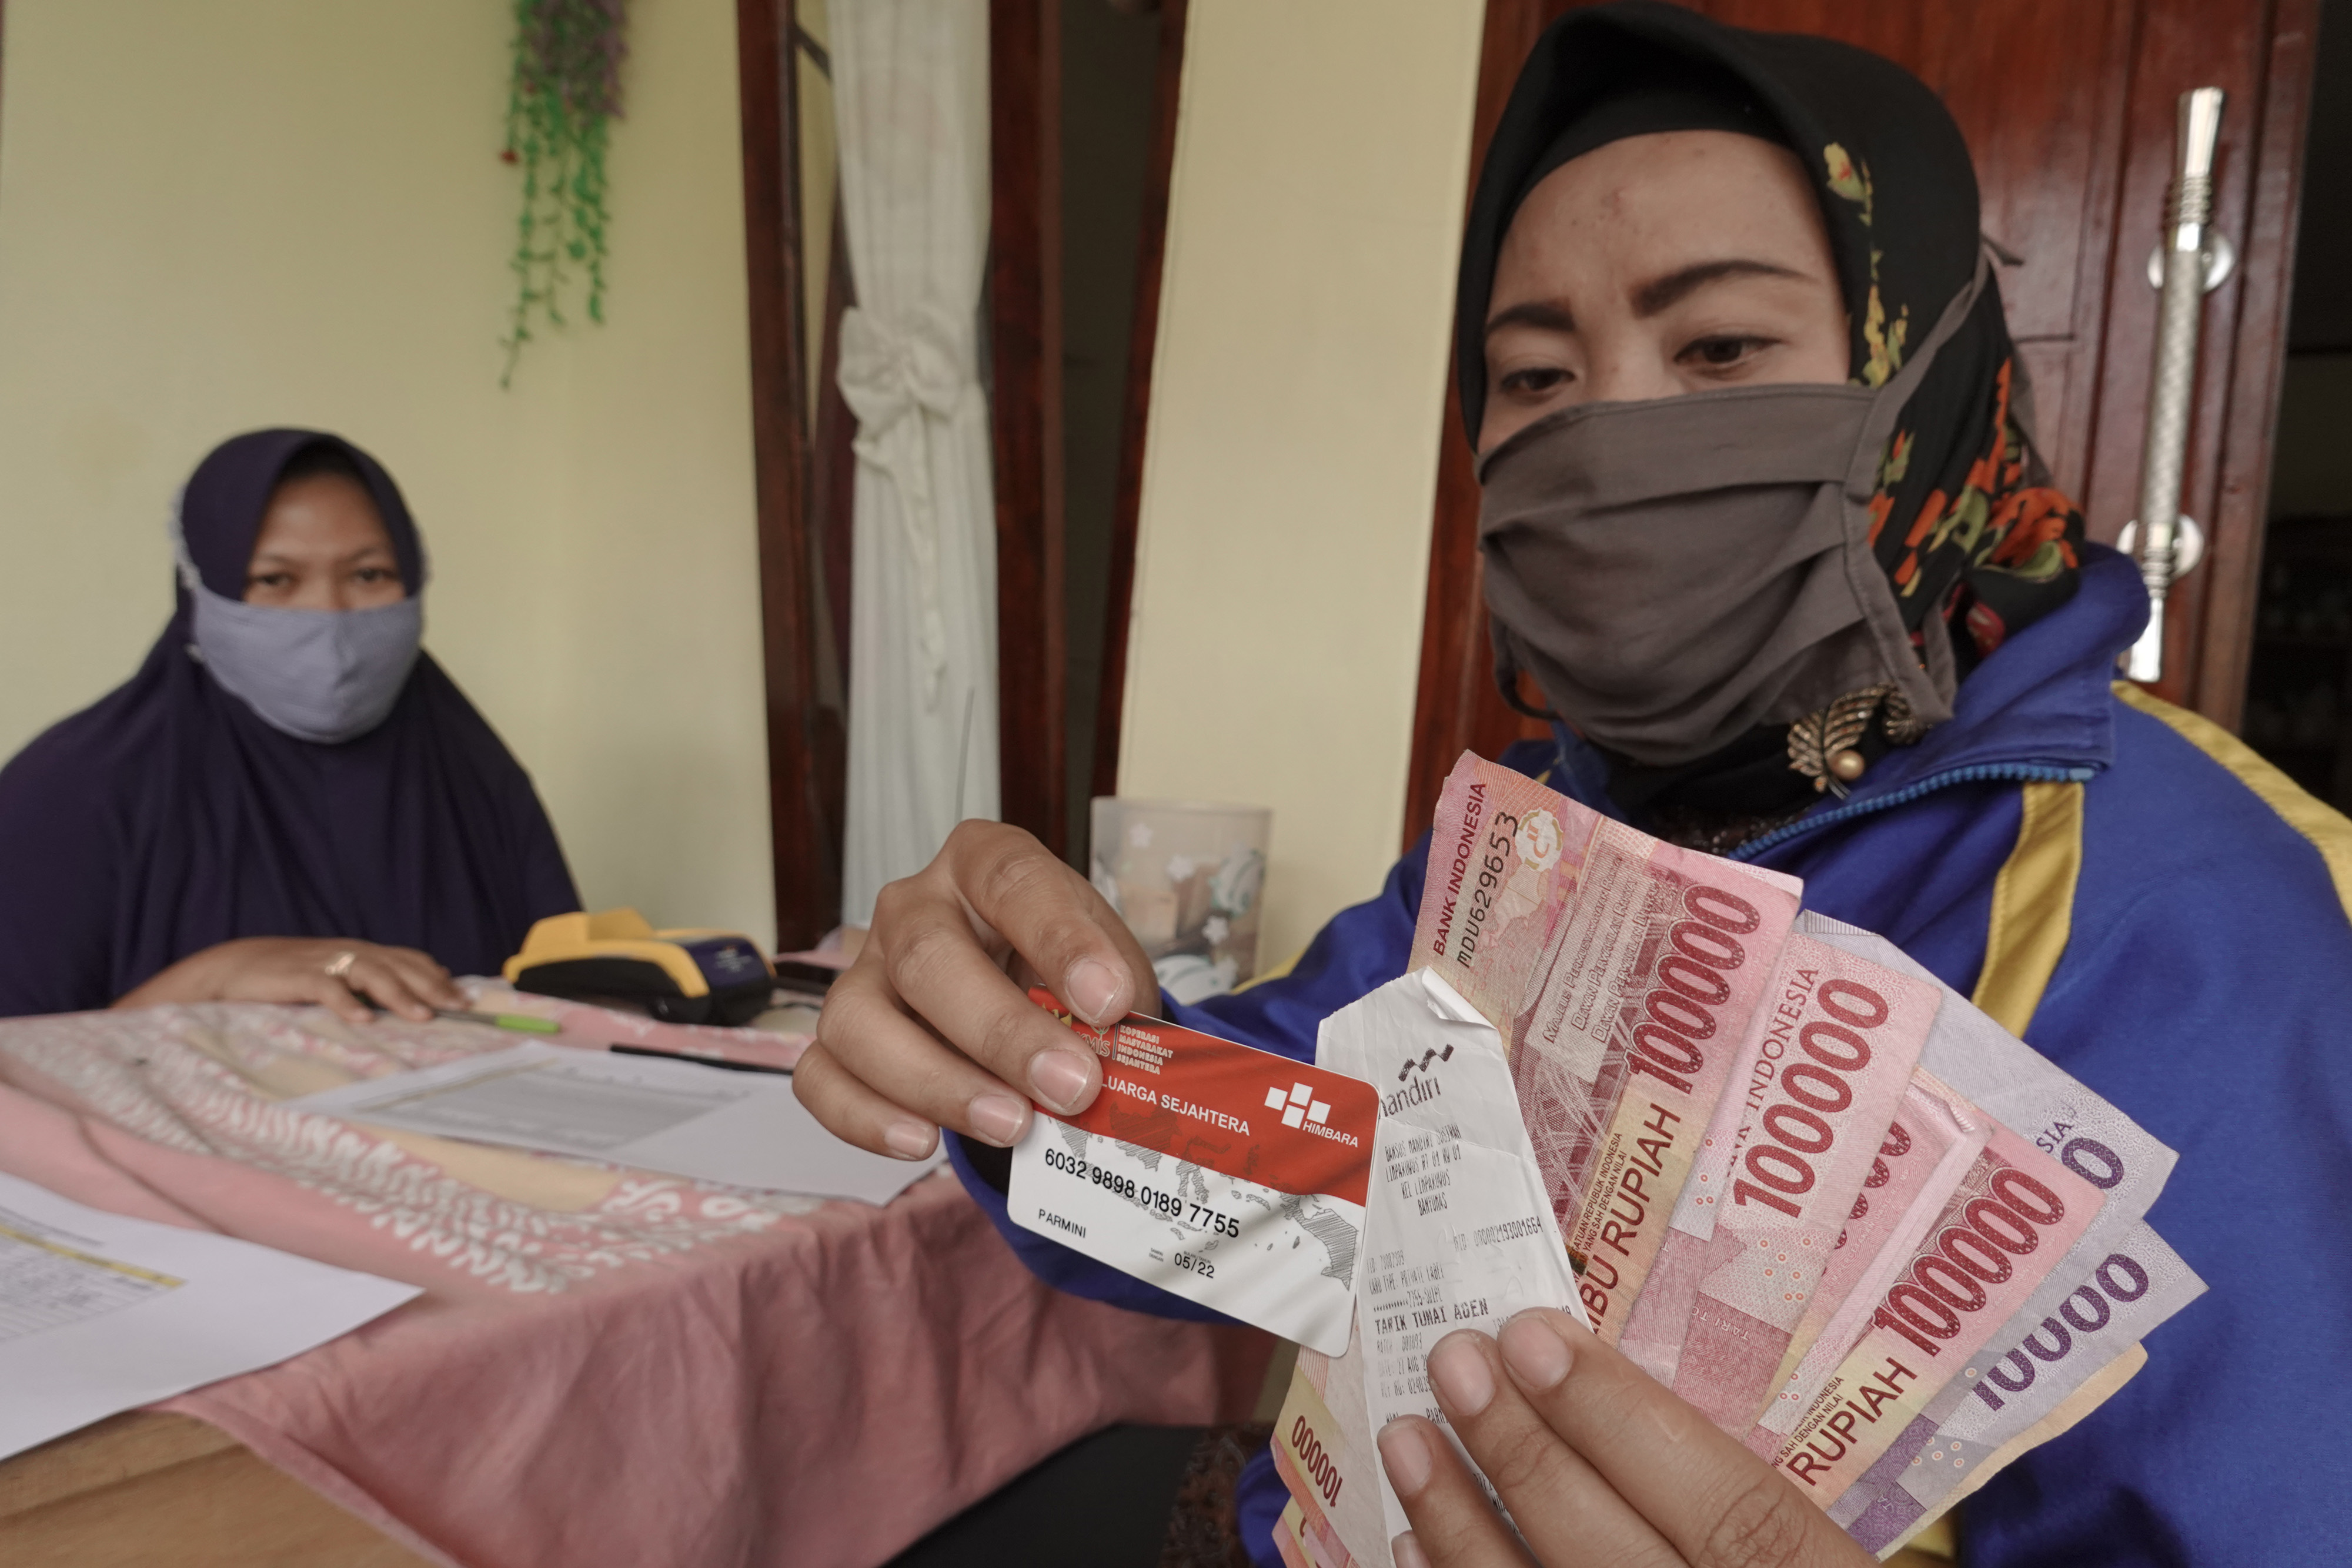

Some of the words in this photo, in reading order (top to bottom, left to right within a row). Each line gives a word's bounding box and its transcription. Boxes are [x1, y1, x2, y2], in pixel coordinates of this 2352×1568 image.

[1433, 896, 1456, 956] BANK
[1448, 783, 1486, 895] INDONESIA
[1456, 811, 1518, 969] MDU629653
[1625, 884, 1761, 1095] 100000
[1118, 1034, 1174, 1058] MASYARAKAT
[1118, 1044, 1163, 1065] INDONESIA
[1120, 1025, 1160, 1044] KOPERASI
[1746, 966, 1819, 1111] INDONESIA
[1117, 1054, 1160, 1075] SEJAHTERA
[1161, 1095, 1250, 1136] SEJAHTERA
[1733, 978, 1889, 1219] 100000
[1302, 1121, 1359, 1148] HIMBARA
[1432, 1150, 1440, 1168] 01
[1453, 1144, 1461, 1161] 01
[1583, 1179, 1605, 1220] REPUBLIK
[1599, 1132, 1623, 1179] INDONESIA
[1045, 1148, 1087, 1179] 6032
[1092, 1166, 1135, 1199] 9898
[1141, 1186, 1182, 1217] 0189
[1189, 1202, 1240, 1238] 7755
[1401, 1181, 1412, 1199] KEL
[1600, 1102, 1681, 1256] RUPIAH
[1417, 1192, 1447, 1216] BANYUMAS
[1582, 1228, 1597, 1252] YANG
[1592, 1211, 1605, 1229] SAH
[1599, 1175, 1619, 1211] DENGAN
[1613, 1151, 1628, 1176] NILAI
[1038, 1208, 1087, 1238] PARMINI
[1174, 1253, 1214, 1279] 05/22
[1426, 1262, 1444, 1282] LABEL
[1872, 1166, 2064, 1357] 100000
[1375, 1314, 1407, 1335] TARIK
[1412, 1306, 1447, 1328] TUNAI
[1454, 1298, 1489, 1320] AGEN
[1407, 1355, 1419, 1373] AUG
[1780, 1441, 1799, 1458] SAH
[1794, 1412, 1826, 1443] DENGAN
[1822, 1393, 1844, 1415] NILAI
[1786, 1357, 1918, 1486] RUPIAH
[1291, 1415, 1343, 1508] 100000
